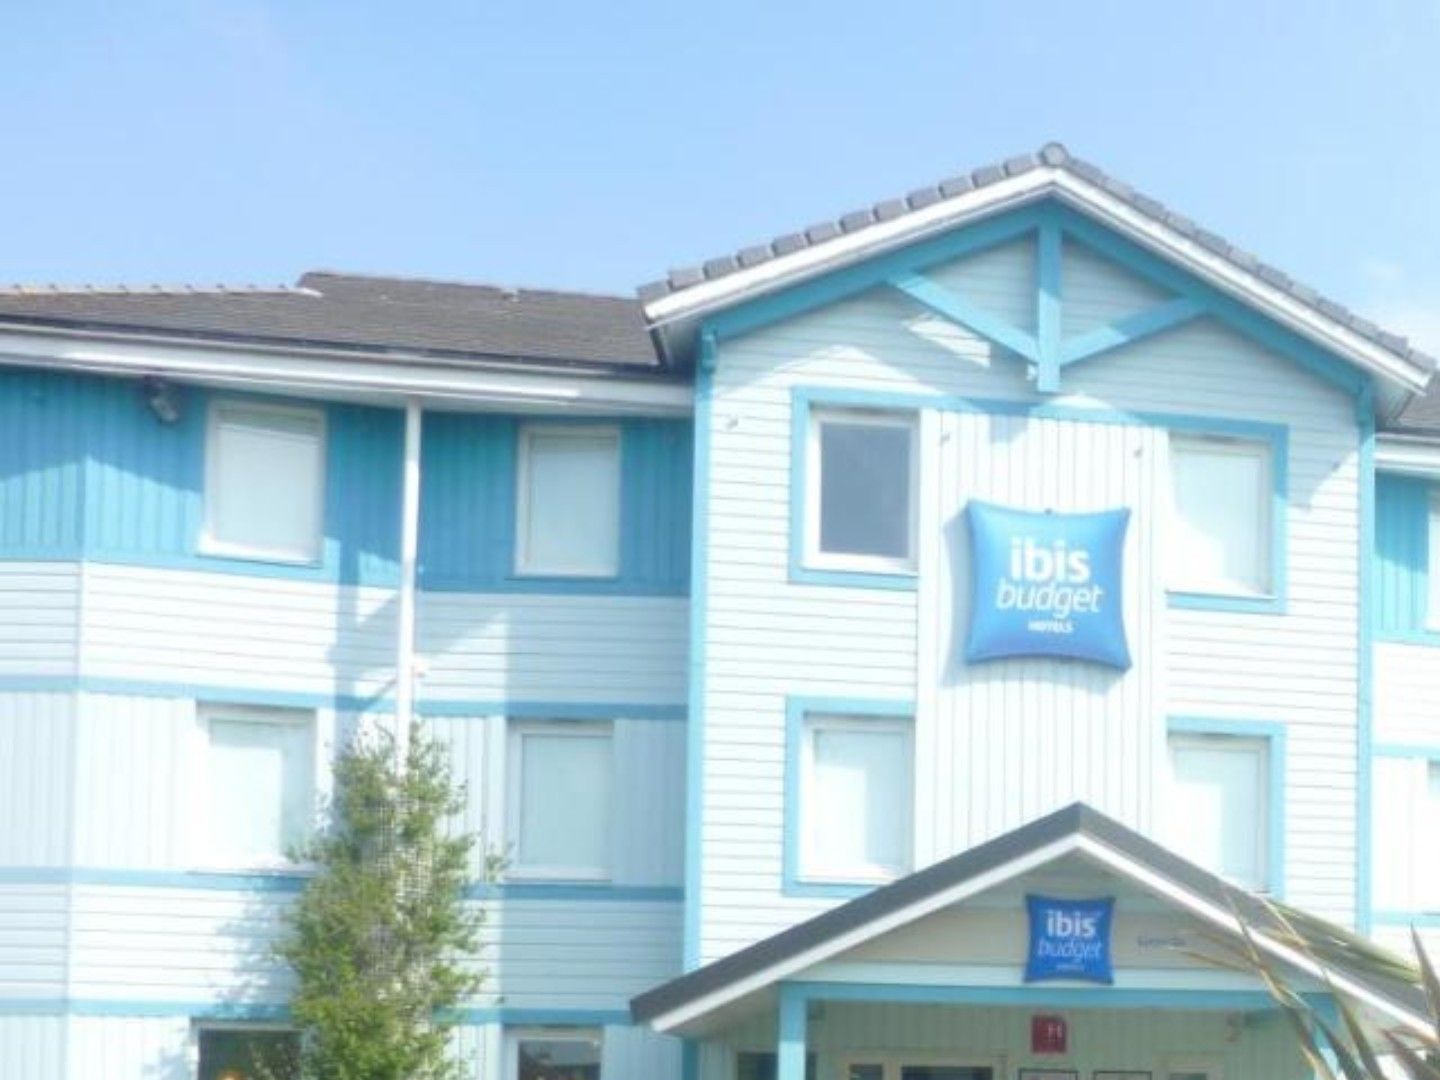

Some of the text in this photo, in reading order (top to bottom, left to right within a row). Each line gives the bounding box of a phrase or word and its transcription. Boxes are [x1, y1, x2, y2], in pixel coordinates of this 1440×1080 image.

[1010, 538, 1091, 583] ibis
[996, 577, 1104, 619] budget
[1046, 909, 1097, 938] ibis
[1037, 936, 1103, 964] budget
